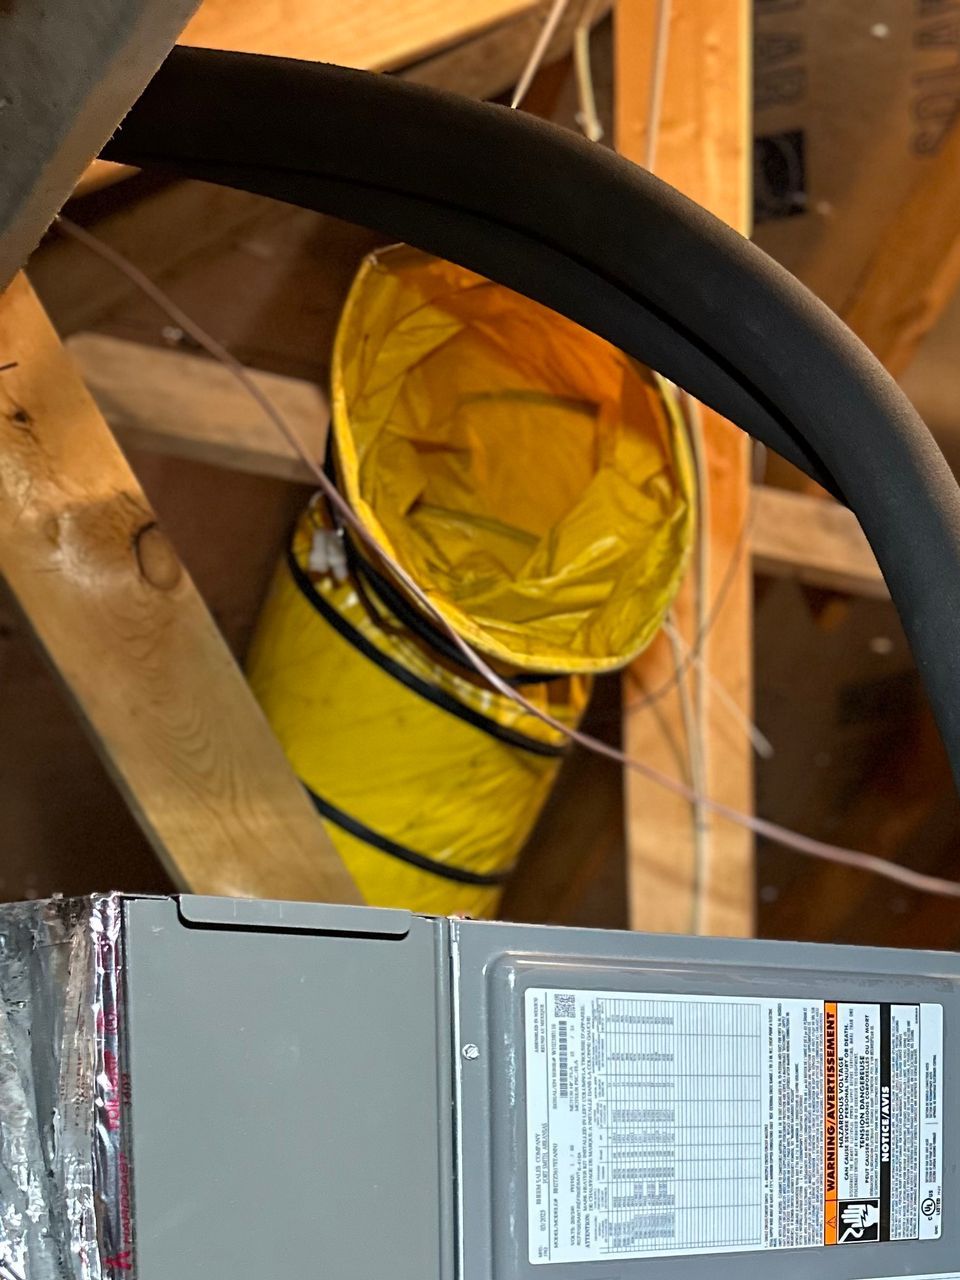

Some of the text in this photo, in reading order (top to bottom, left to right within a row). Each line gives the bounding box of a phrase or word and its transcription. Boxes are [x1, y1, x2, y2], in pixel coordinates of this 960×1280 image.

[844, 1048, 849, 1058] OR
[865, 1044, 870, 1054] OU
[827, 1012, 836, 1191] WARNING/AVERTISSEMENT
[882, 1086, 890, 1162] NOTICE/AVIS
